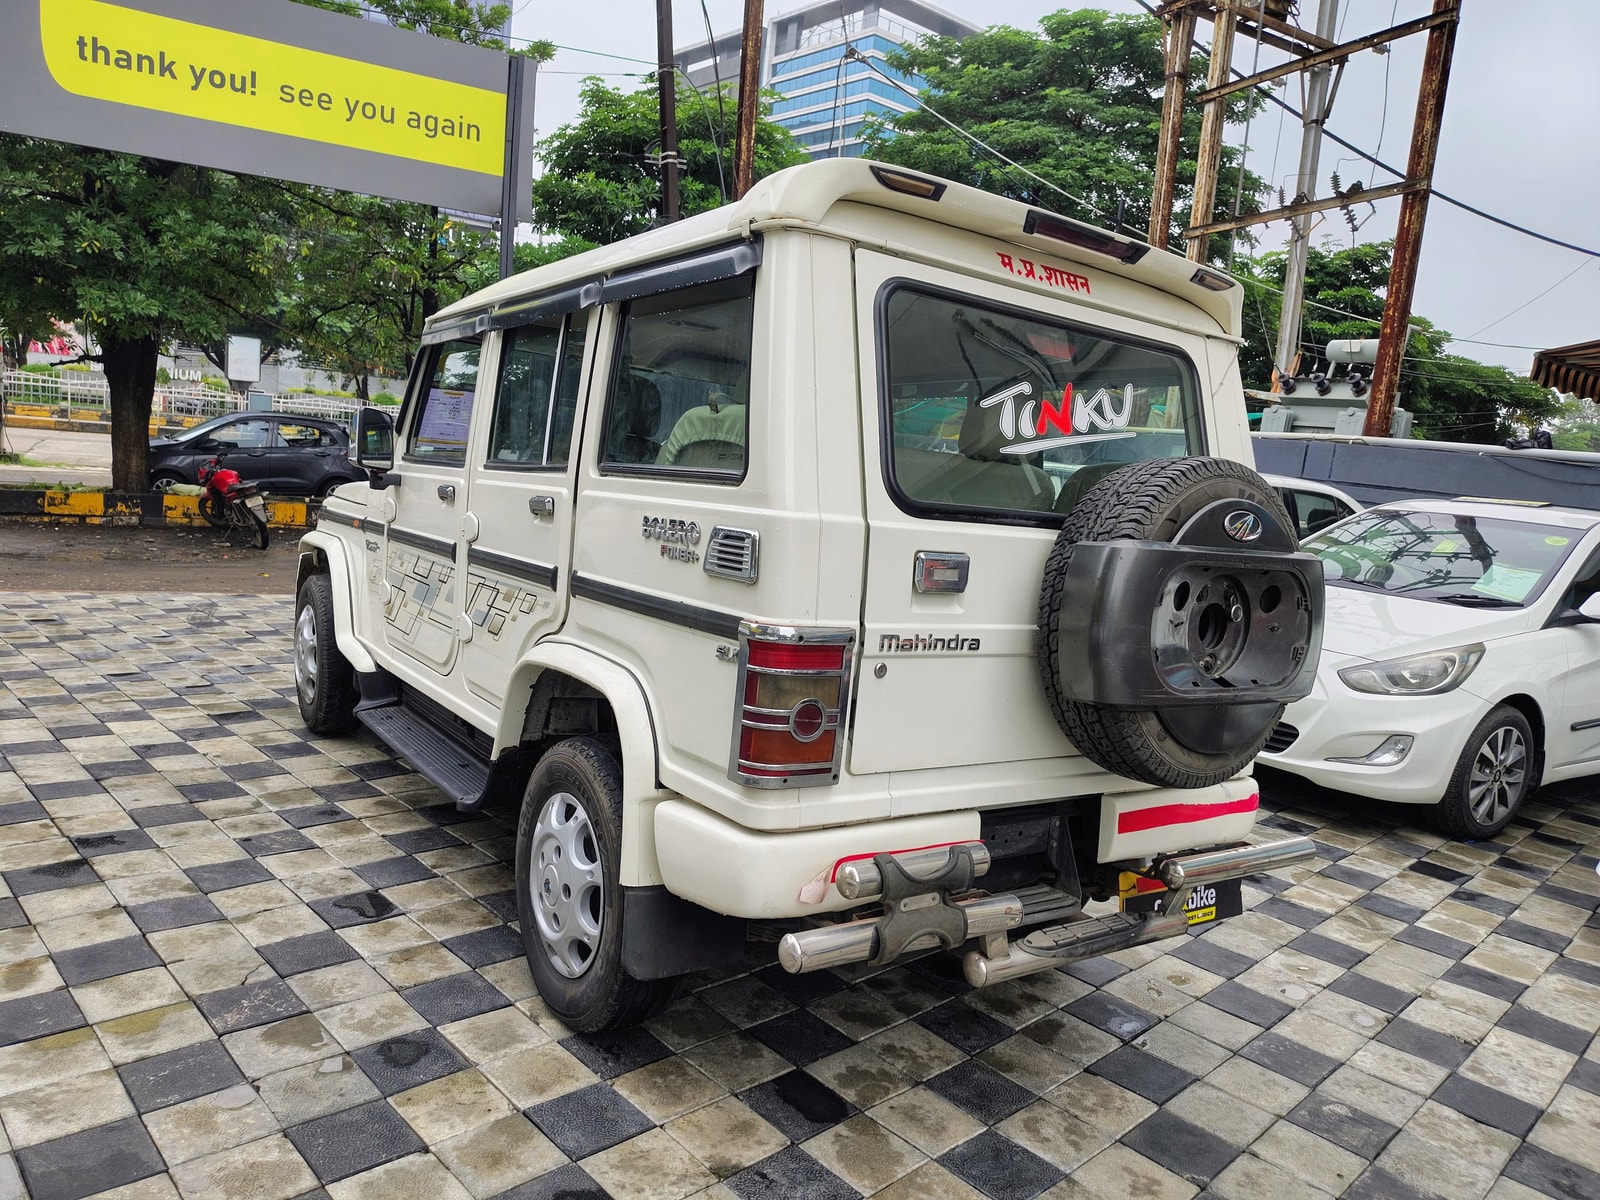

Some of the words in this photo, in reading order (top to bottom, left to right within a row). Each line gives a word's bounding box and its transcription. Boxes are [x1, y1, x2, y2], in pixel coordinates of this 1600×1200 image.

[77, 35, 178, 80] thank
[189, 64, 257, 96] you!
[279, 84, 333, 111] see
[344, 97, 395, 124] you
[406, 111, 481, 142] again
[642, 515, 701, 545] BOLERO
[879, 633, 980, 652] Mahindra
